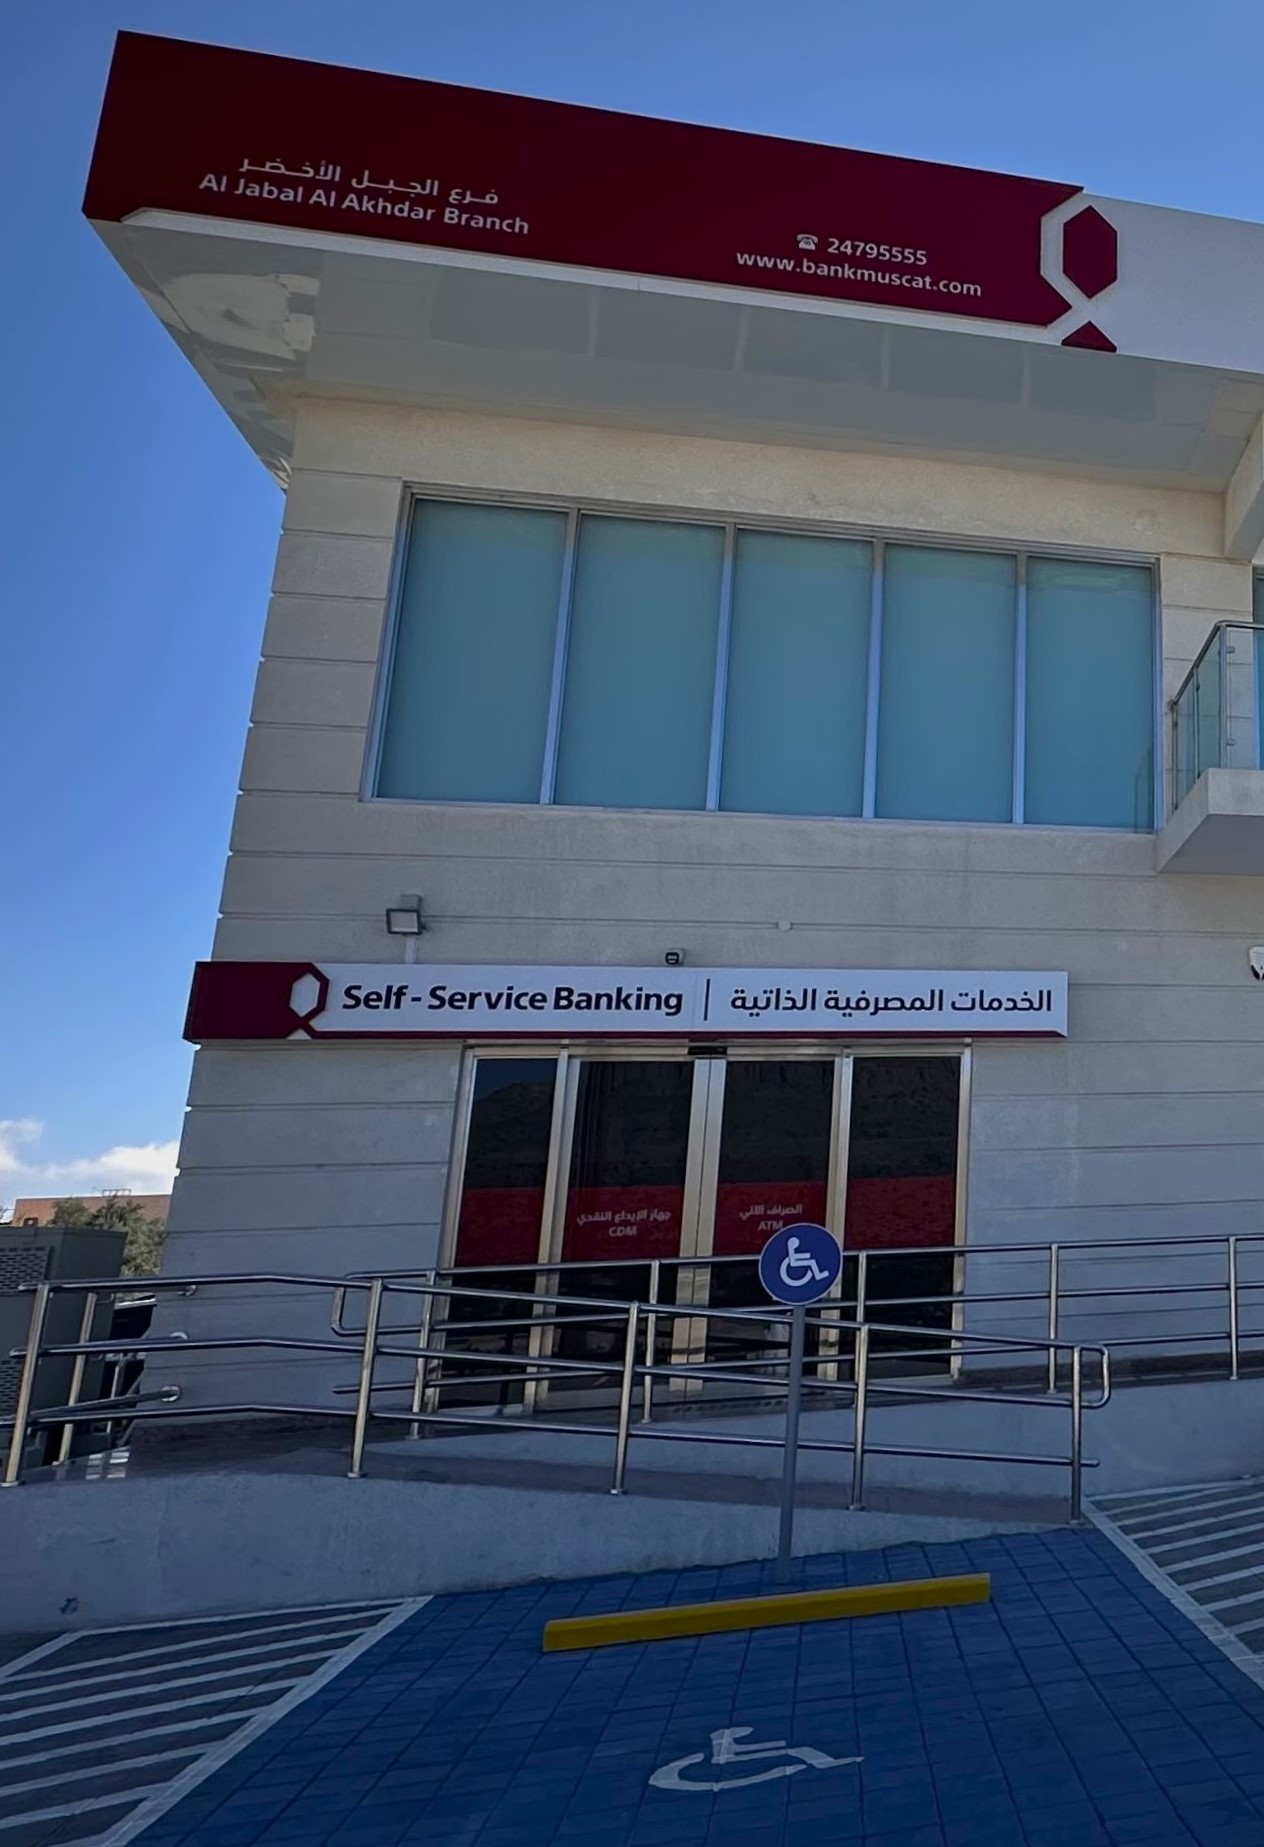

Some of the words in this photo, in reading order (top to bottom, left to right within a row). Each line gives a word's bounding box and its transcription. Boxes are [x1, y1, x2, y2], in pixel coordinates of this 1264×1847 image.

[239, 158, 341, 182] الأخضر
[351, 170, 439, 197] الجبل
[199, 173, 226, 192] Al
[234, 178, 303, 204] Jabal
[308, 188, 336, 207] Al
[341, 193, 437, 222] Akhdar
[443, 207, 530, 235] Branch
[449, 189, 499, 205] فرع
[827, 238, 928, 265] 24795555
[736, 252, 982, 297] www.bankmuscat.com
[553, 985, 683, 1016] Banking
[730, 987, 817, 1018] الذاتية
[823, 988, 944, 1018] المصرفية
[950, 989, 1052, 1012] الخدمات
[608, 1226, 638, 1237] CDM
[758, 1220, 784, 1231] ATM
